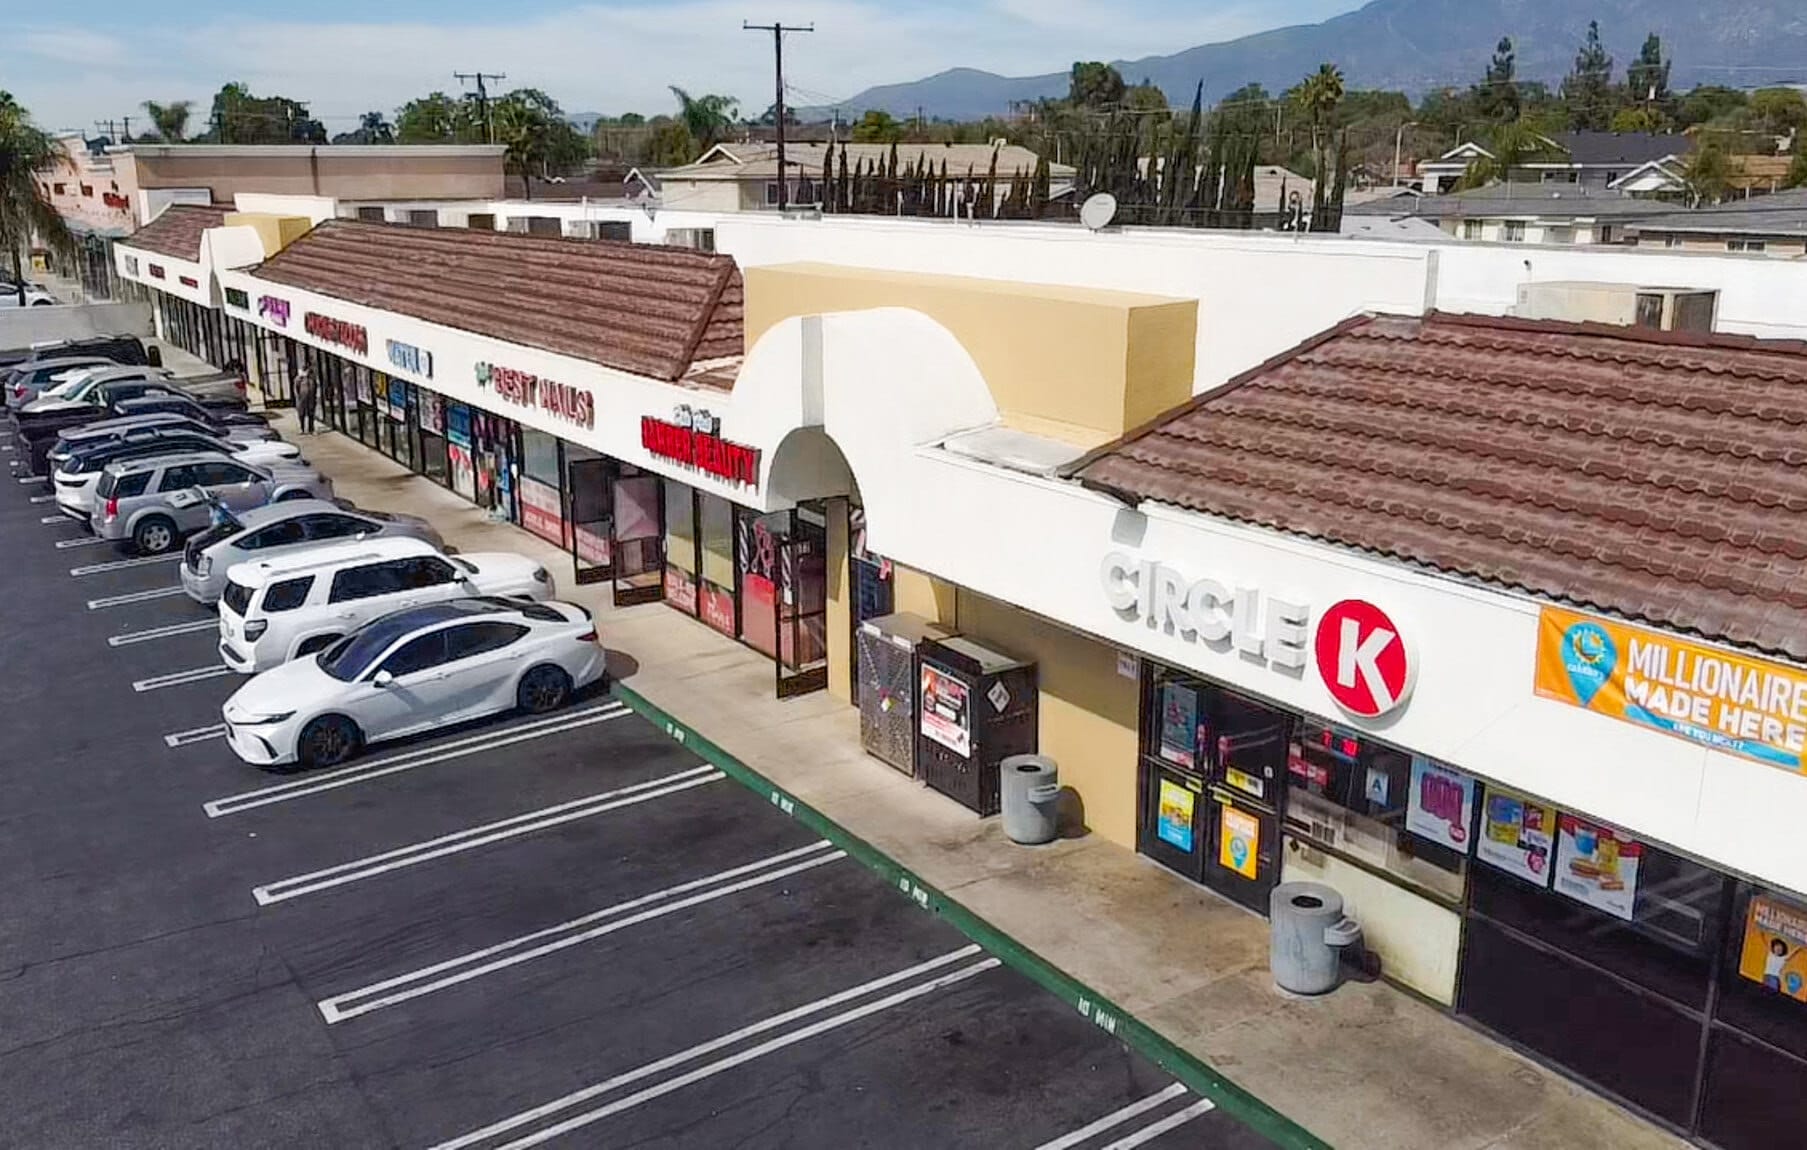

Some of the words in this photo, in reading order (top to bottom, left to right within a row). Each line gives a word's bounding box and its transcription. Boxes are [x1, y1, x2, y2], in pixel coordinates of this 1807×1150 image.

[493, 366, 537, 408] BEST
[539, 378, 594, 430] NAILS
[694, 431, 761, 487] BEAUTY
[1100, 551, 1310, 668] CIRCLE
[1337, 617, 1397, 713] K
[1624, 675, 1711, 725] MADE
[1719, 703, 1806, 752] HERE
[1372, 778, 1383, 794] A
